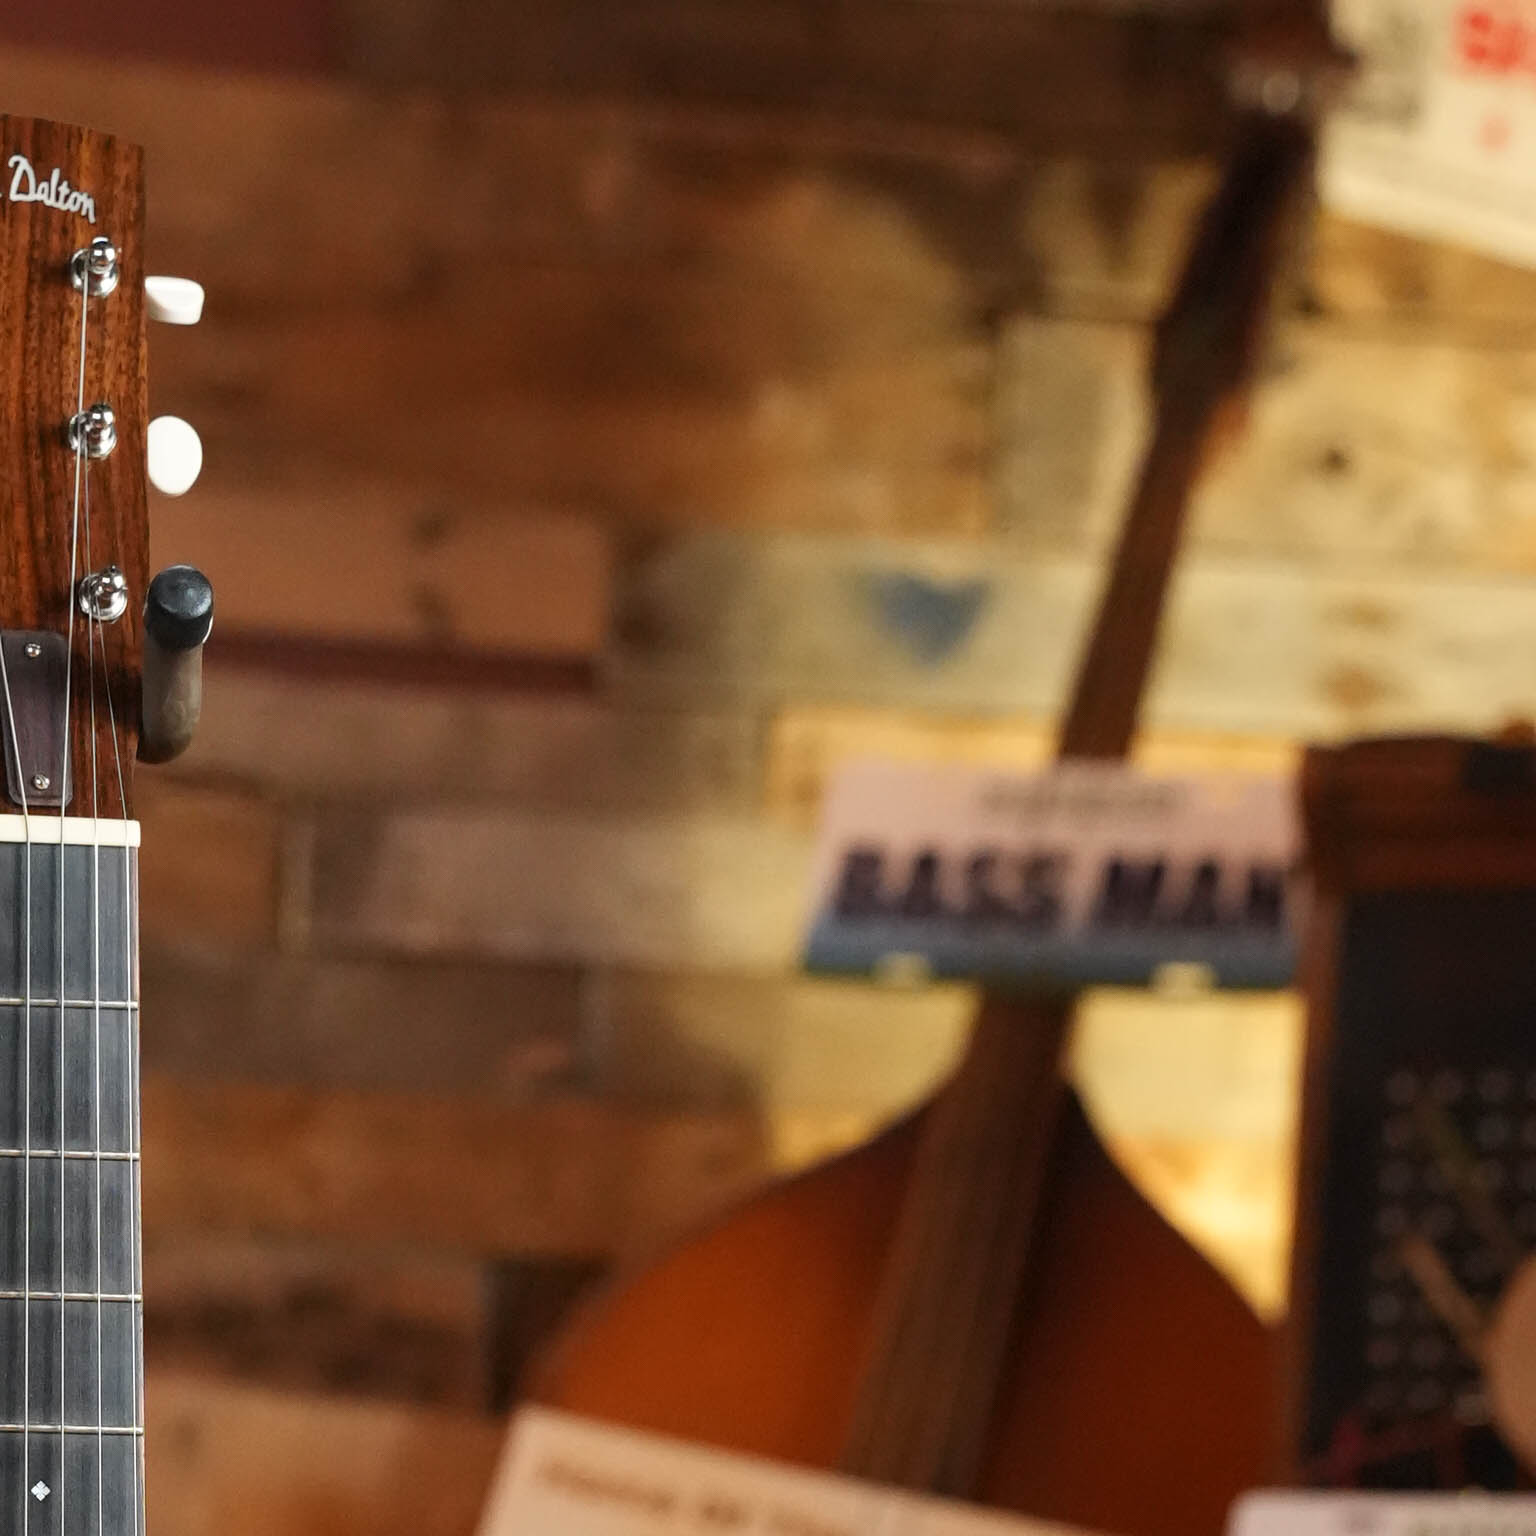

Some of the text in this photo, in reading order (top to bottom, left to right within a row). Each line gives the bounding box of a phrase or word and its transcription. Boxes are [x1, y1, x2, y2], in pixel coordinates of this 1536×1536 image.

[8, 154, 97, 224] Dalton
[832, 848, 1286, 936] BASS MAN
